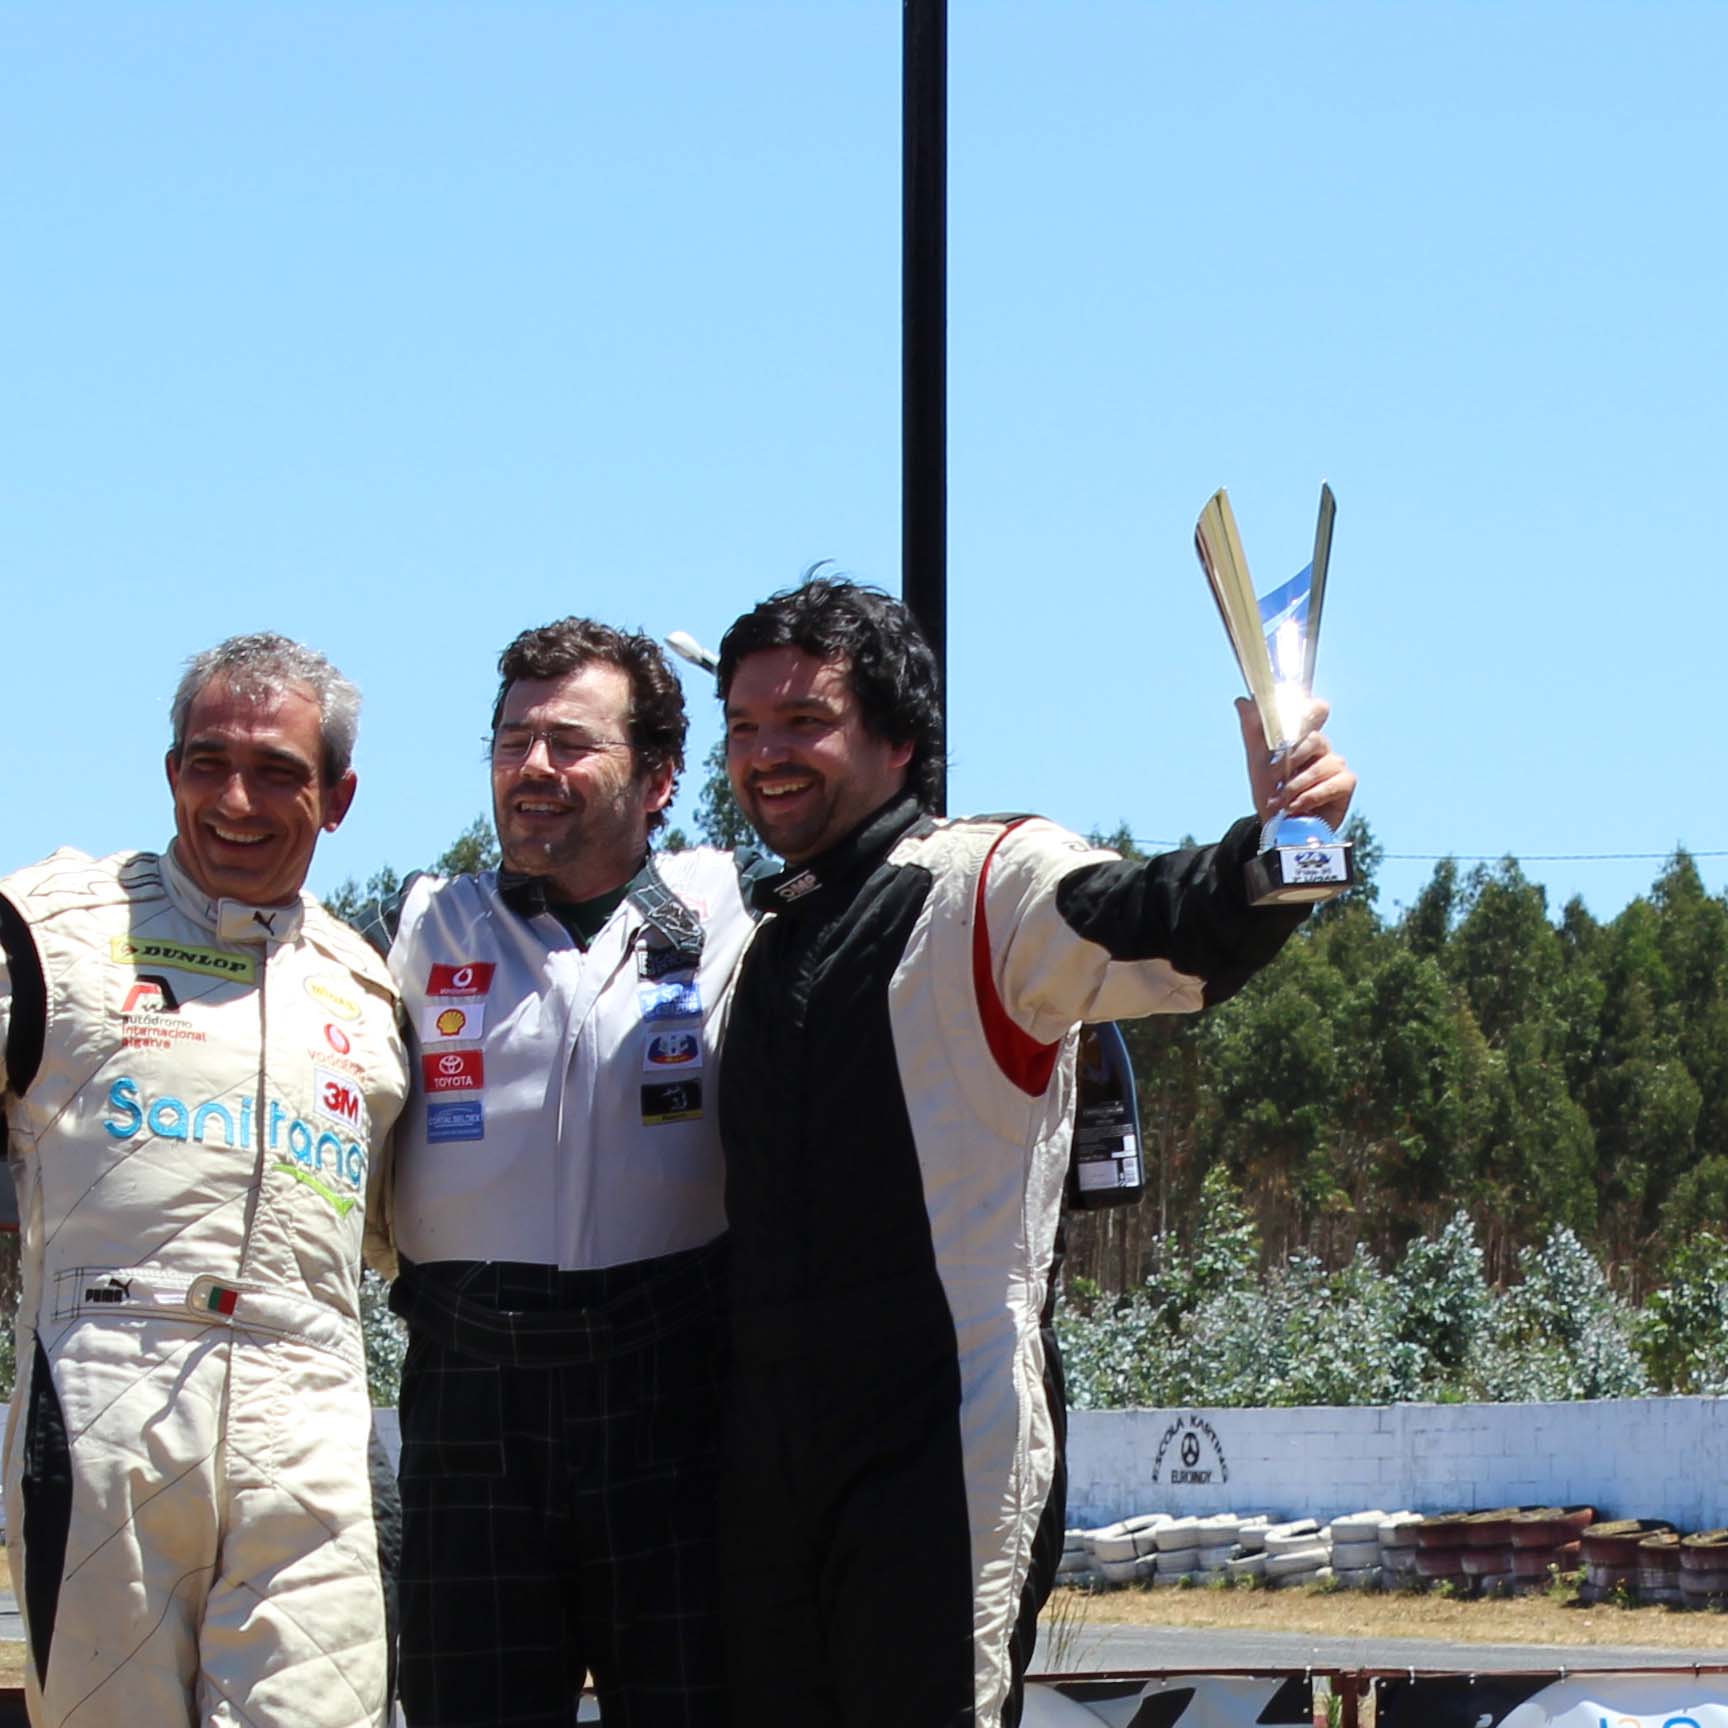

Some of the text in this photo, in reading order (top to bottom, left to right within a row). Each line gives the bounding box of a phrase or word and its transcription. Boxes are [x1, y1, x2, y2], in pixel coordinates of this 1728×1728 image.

[142, 946, 248, 973] DUNLOP
[434, 1076, 473, 1088] TOYOTA
[323, 1081, 359, 1125] 3M
